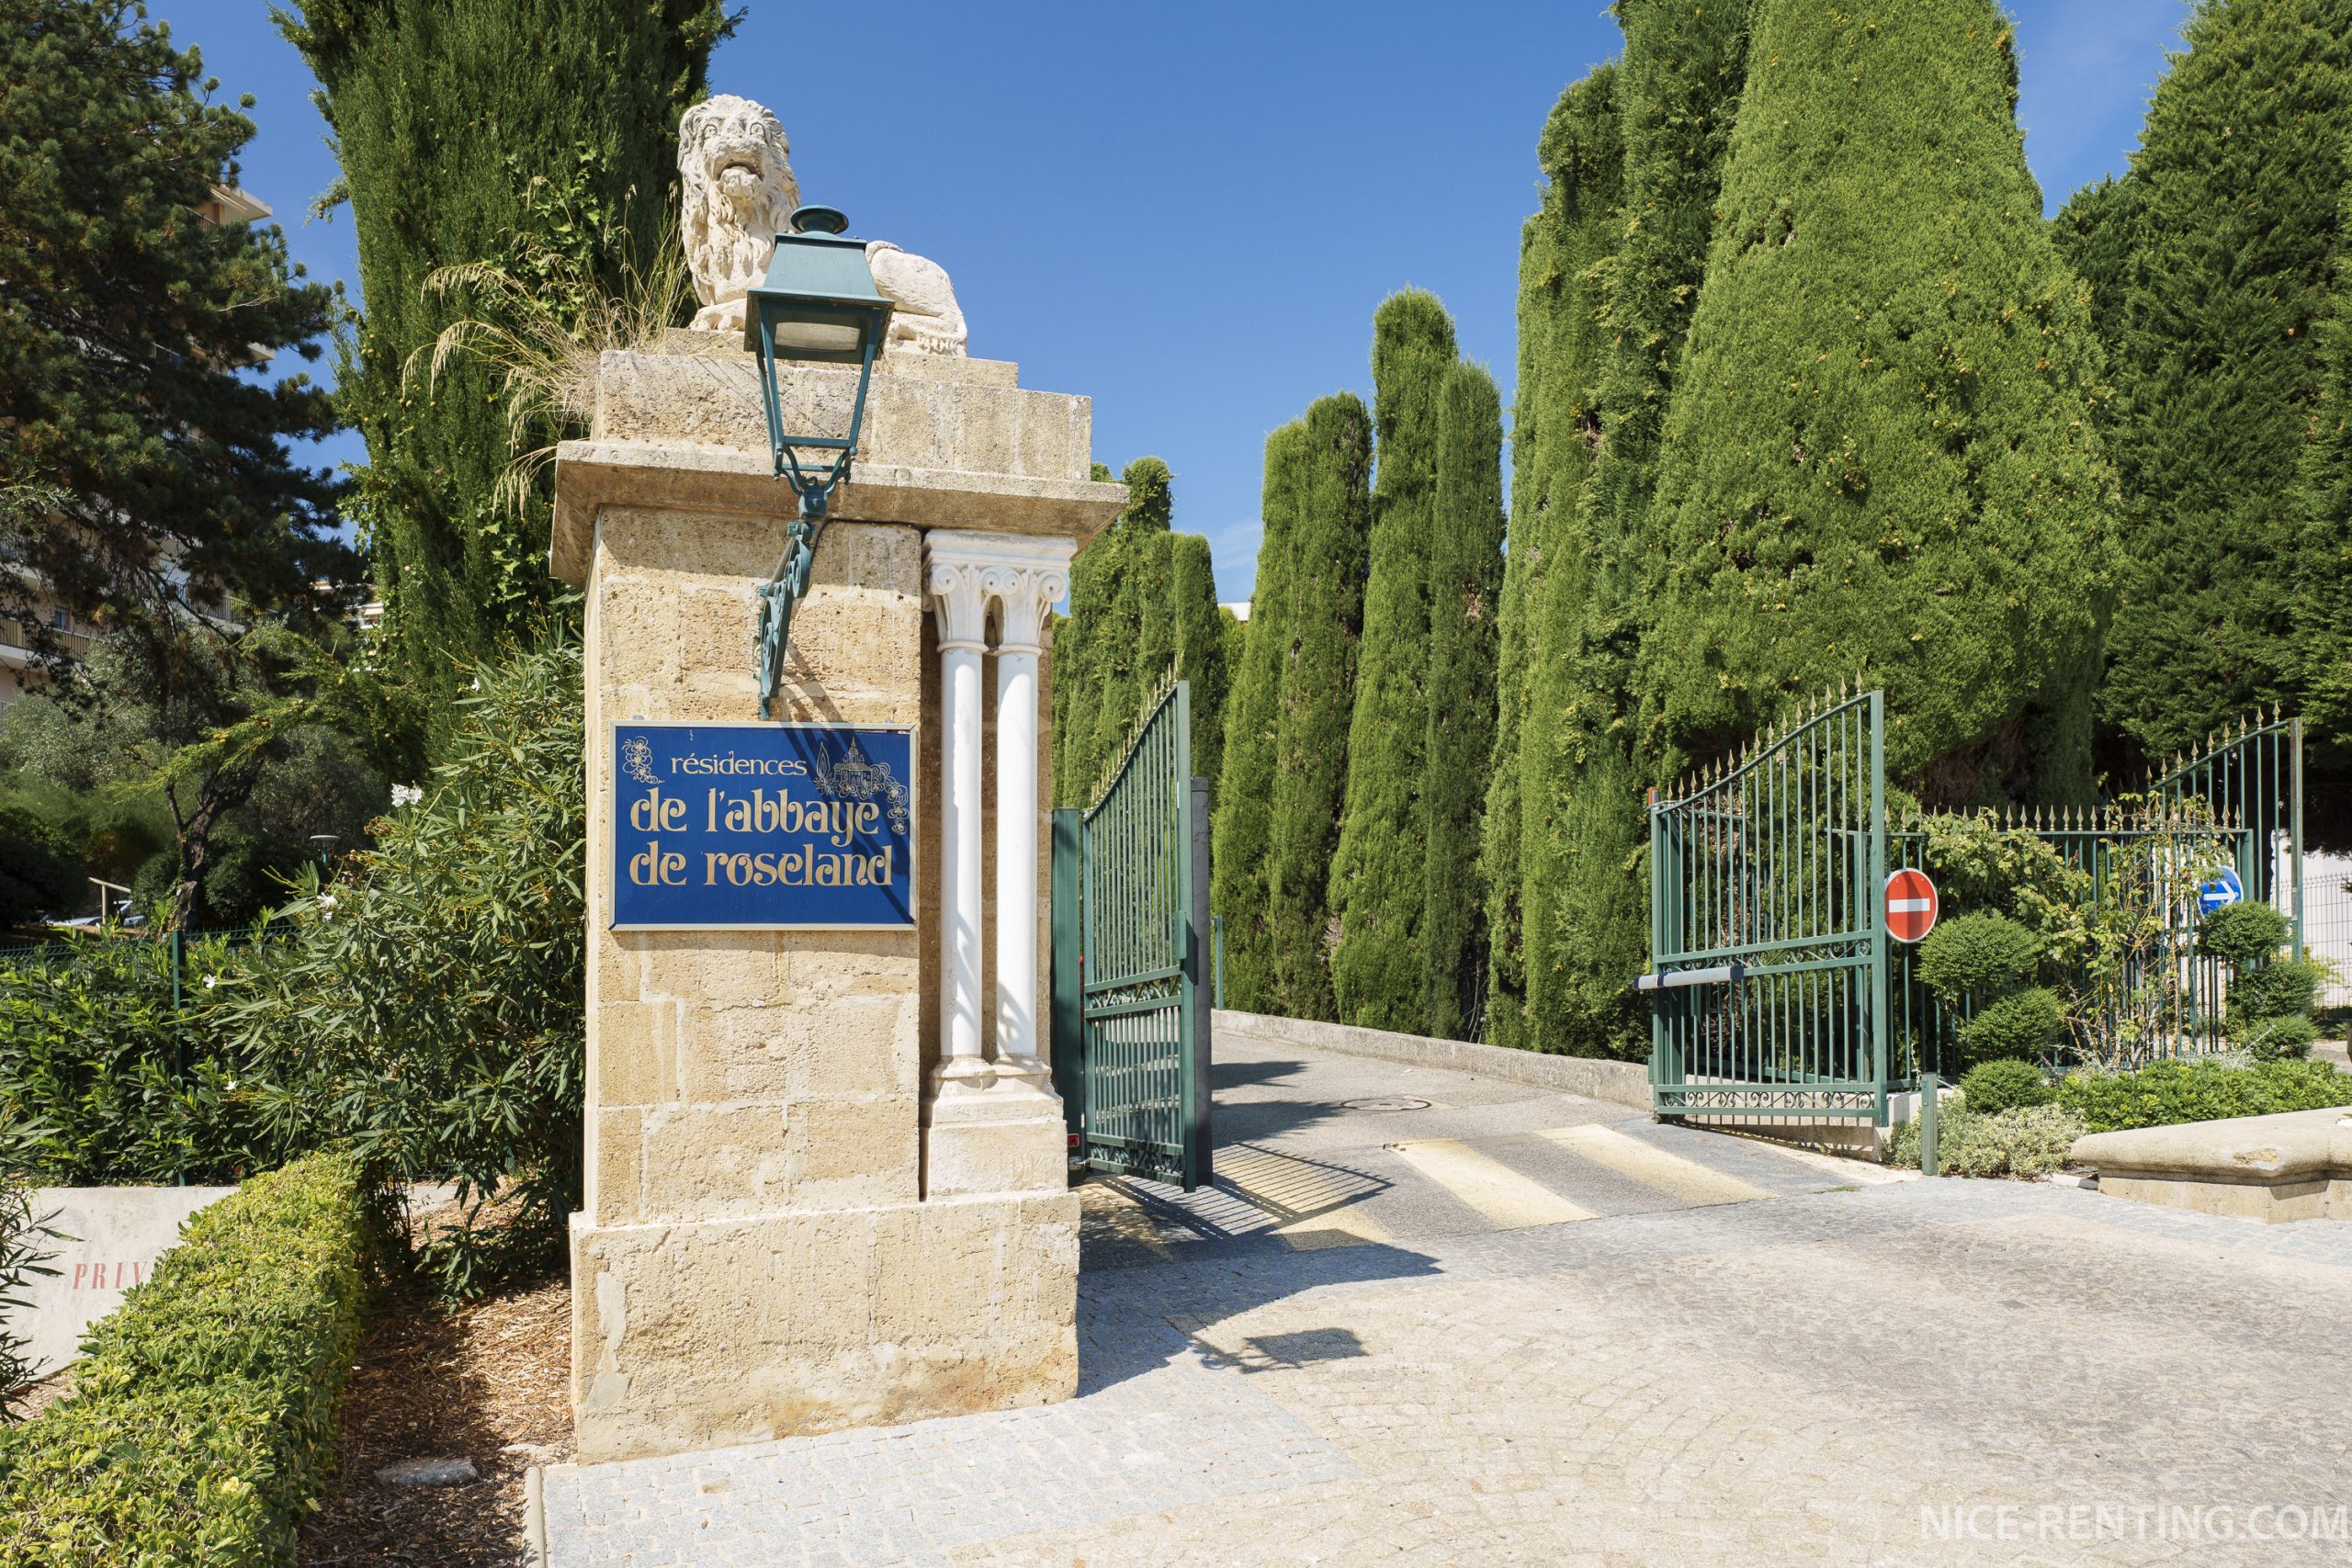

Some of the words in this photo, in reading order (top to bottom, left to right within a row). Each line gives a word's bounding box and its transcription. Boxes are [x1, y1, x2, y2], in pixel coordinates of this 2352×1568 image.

[672, 751, 807, 775] résidences
[630, 787, 687, 832] de
[705, 787, 879, 847] l'abbaye
[630, 840, 687, 886] de
[704, 843, 892, 886] roseland
[73, 1261, 156, 1290] PRIV
